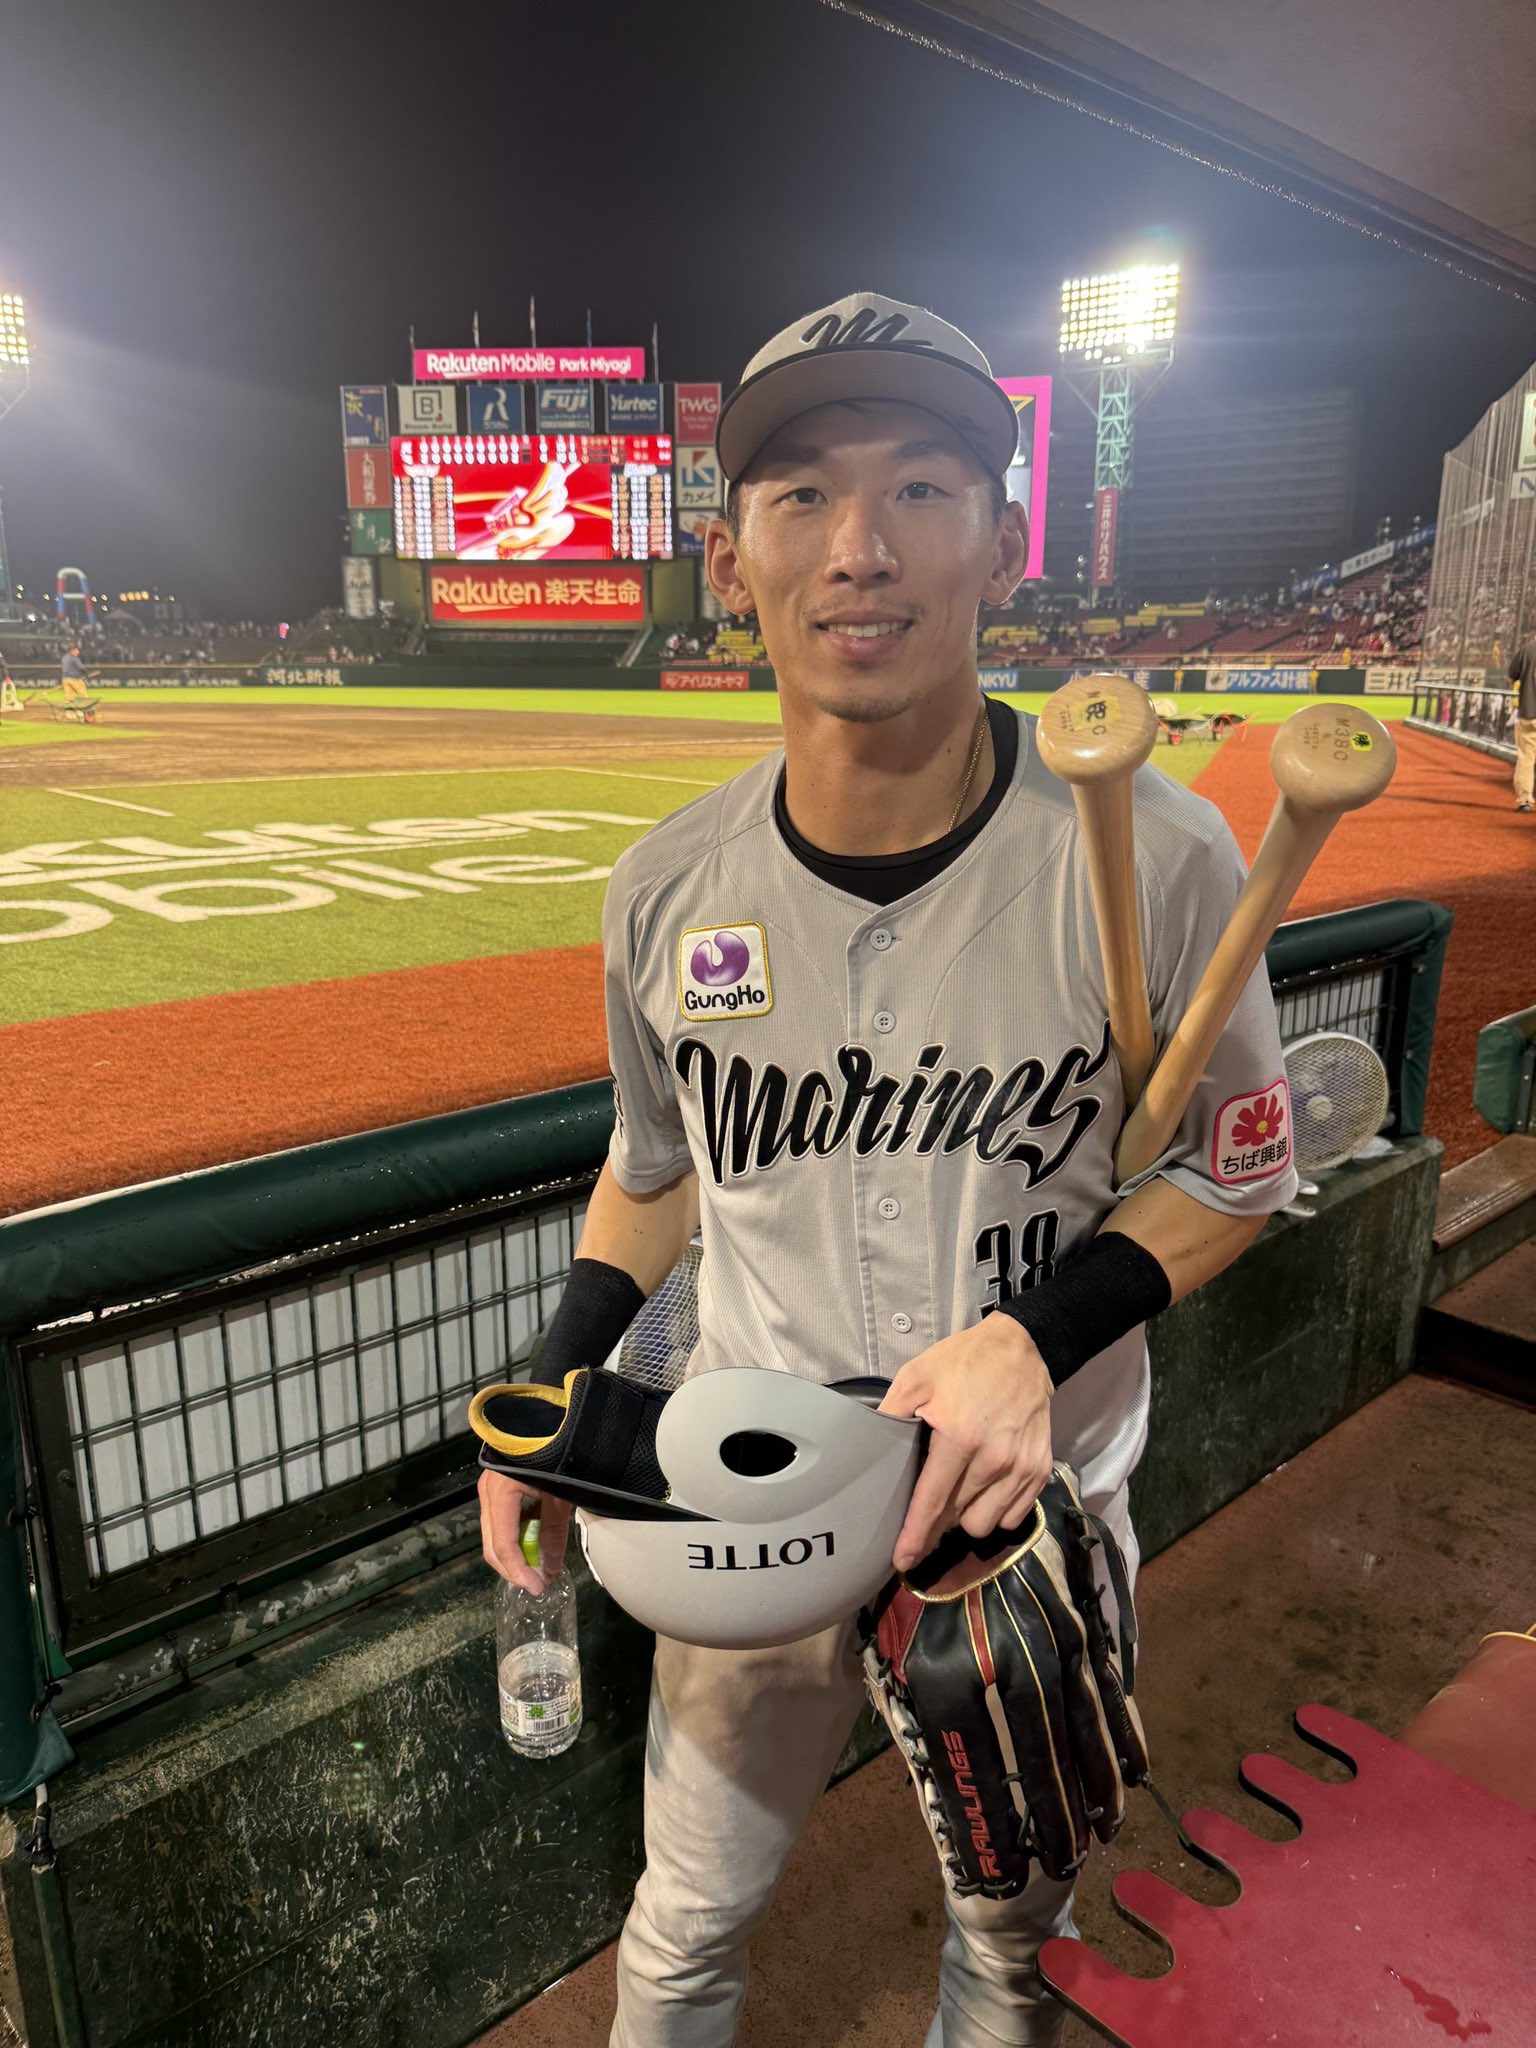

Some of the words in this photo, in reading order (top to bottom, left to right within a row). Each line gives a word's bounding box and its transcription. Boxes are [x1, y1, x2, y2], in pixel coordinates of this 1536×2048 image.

[427, 353, 500, 373] Rakuten
[501, 353, 555, 372] Mobile
[559, 357, 589, 372] Park
[590, 356, 632, 374] Miyagi
[541, 389, 588, 412] Fuji
[611, 394, 657, 412] Yurtec
[681, 397, 717, 413] TWG
[682, 491, 716, 504] カメイ
[431, 574, 541, 604] Rakuten
[545, 578, 641, 605] 楽天生命
[977, 671, 1017, 688] NKYU
[685, 985, 765, 1010] GungHo
[675, 1018, 1110, 1192] Marines
[1222, 1136, 1288, 1175] ちば興銀
[973, 1207, 1060, 1320] 38
[687, 1531, 835, 1570] LOTTE
[941, 1729, 1003, 1878] RAWLINGS
